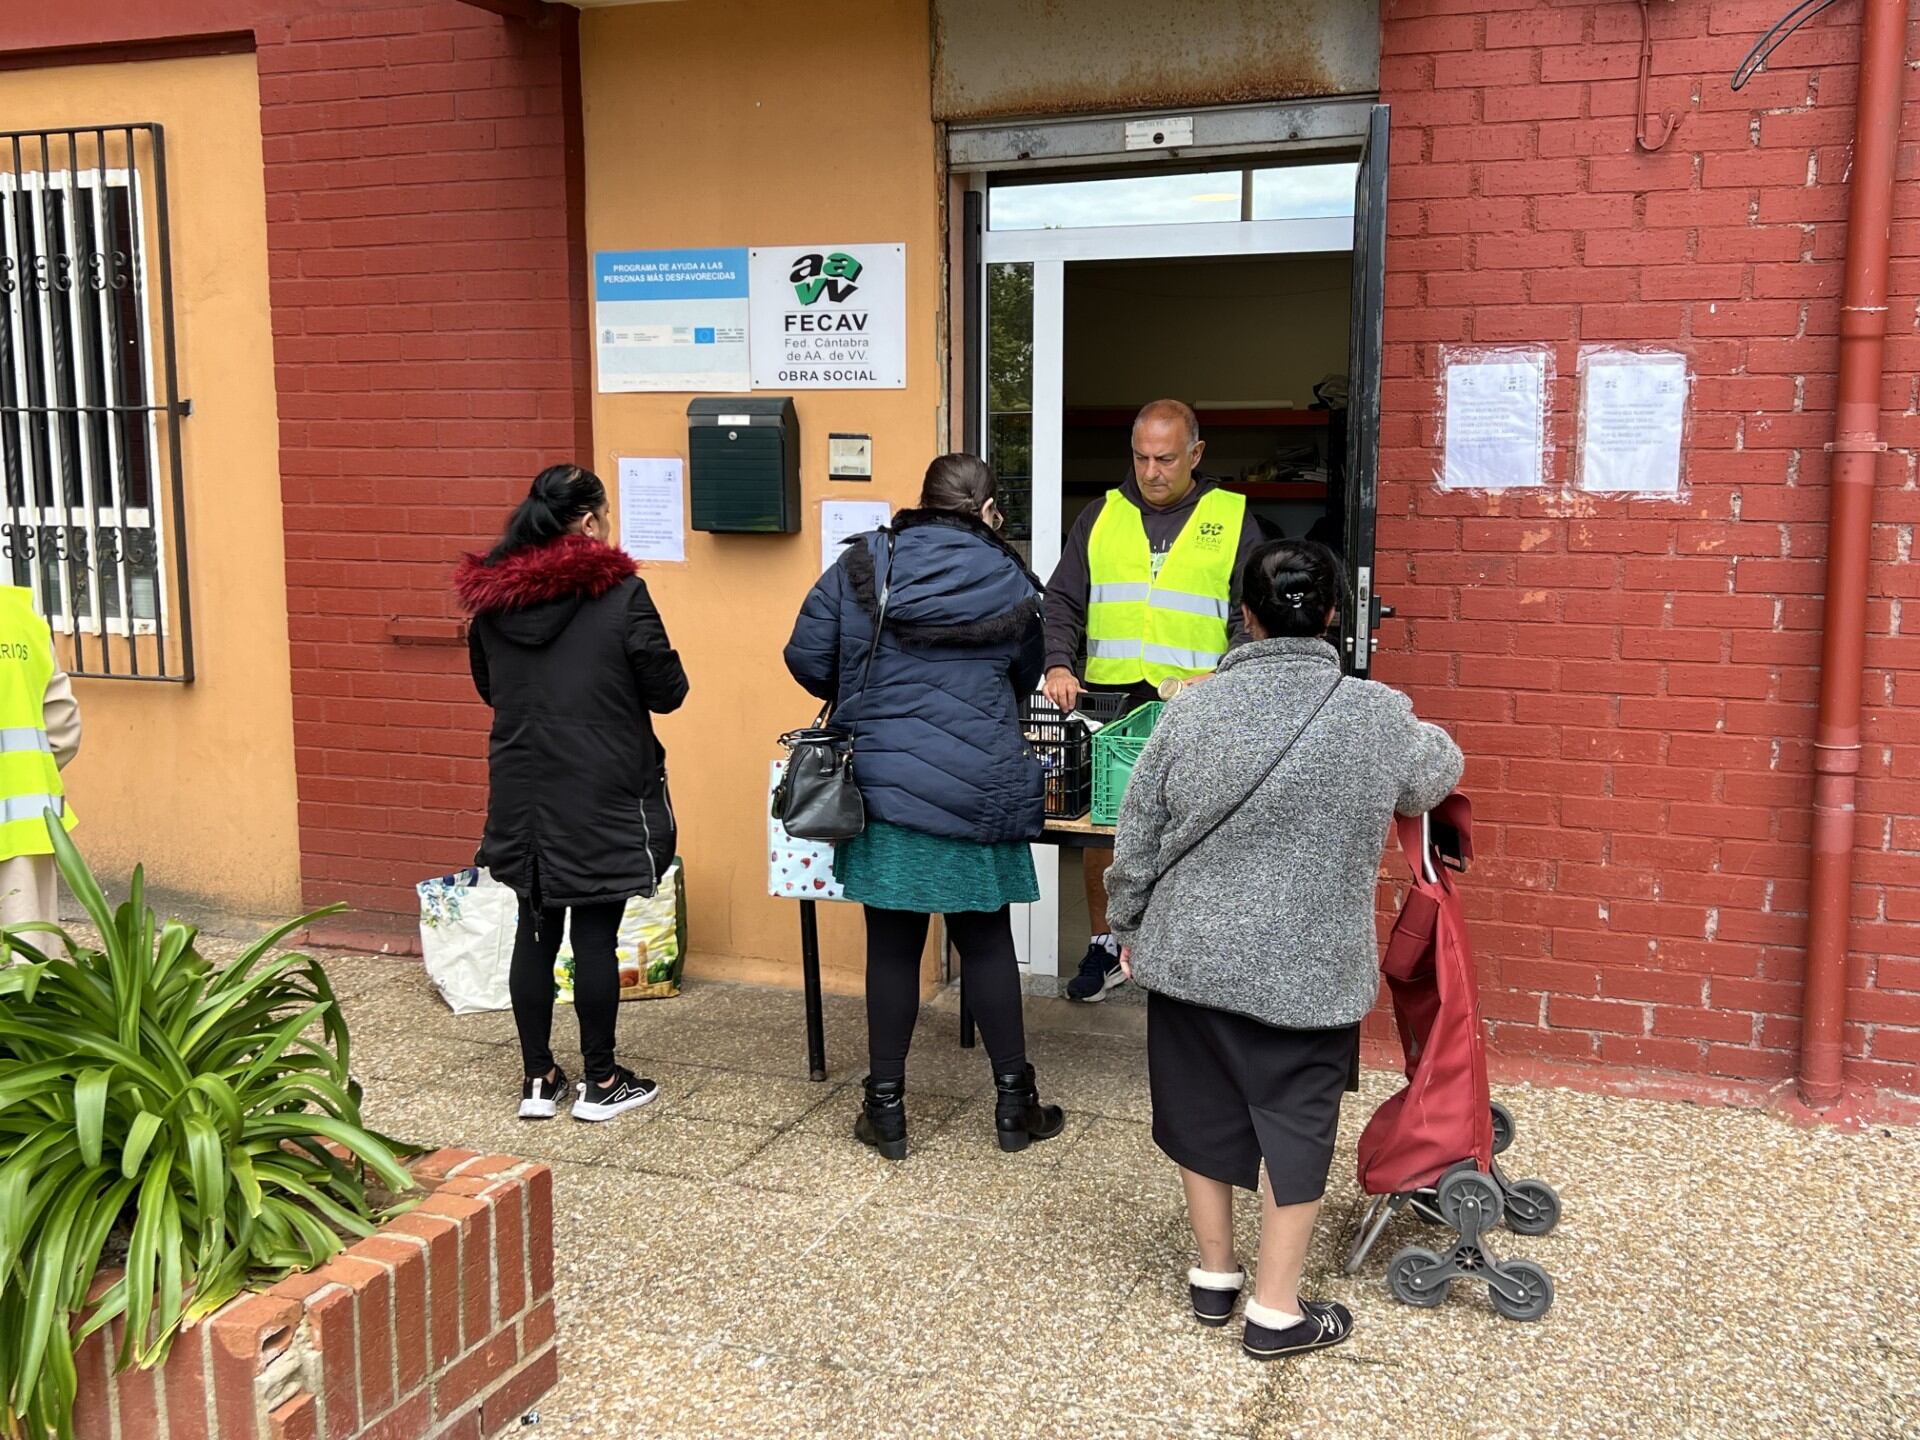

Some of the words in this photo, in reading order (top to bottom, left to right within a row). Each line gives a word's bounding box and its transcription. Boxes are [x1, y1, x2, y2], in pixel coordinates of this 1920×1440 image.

[613, 264, 657, 272] PROGRAMA
[659, 263, 669, 271] DE
[671, 262, 699, 271] AYUDA
[700, 262, 706, 270] A
[707, 261, 723, 270] LAS
[604, 275, 645, 283] PERSONAS
[646, 272, 664, 282] MÁS
[665, 271, 736, 281] DESFAVORECIDAS
[784, 313, 868, 332] FECAV
[785, 338, 810, 348] Fed.
[815, 337, 869, 348] Cántabra
[786, 351, 801, 361] de
[804, 350, 825, 360] AA.
[829, 350, 844, 360] de
[848, 350, 868, 360] VV.
[778, 370, 819, 381] OBRA
[823, 370, 877, 381] SOCIAL
[1196, 535, 1222, 545] FECAV
[0, 643, 28, 661] RIOS
